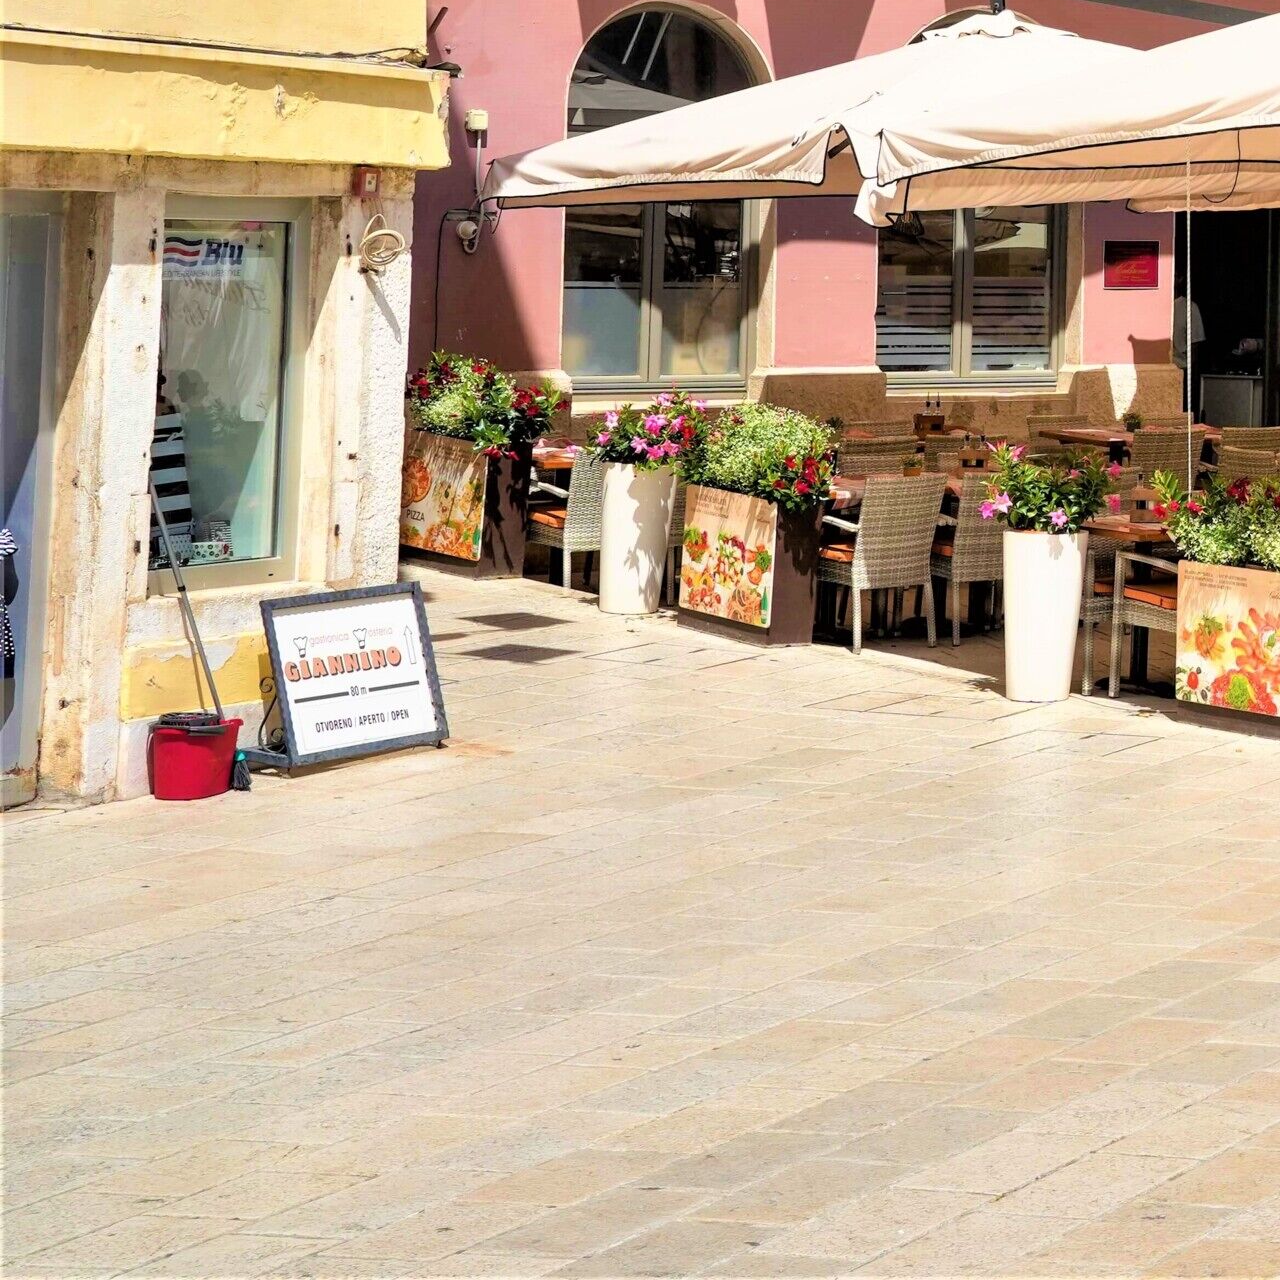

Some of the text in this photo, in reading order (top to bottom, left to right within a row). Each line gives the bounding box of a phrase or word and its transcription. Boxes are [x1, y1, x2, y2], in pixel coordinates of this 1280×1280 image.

[284, 646, 402, 683] GIANNINO
[350, 685, 367, 697] 80 m
[315, 717, 353, 733] OTVORENO
[358, 712, 386, 726] APERTO
[391, 708, 410, 721] OPEN
